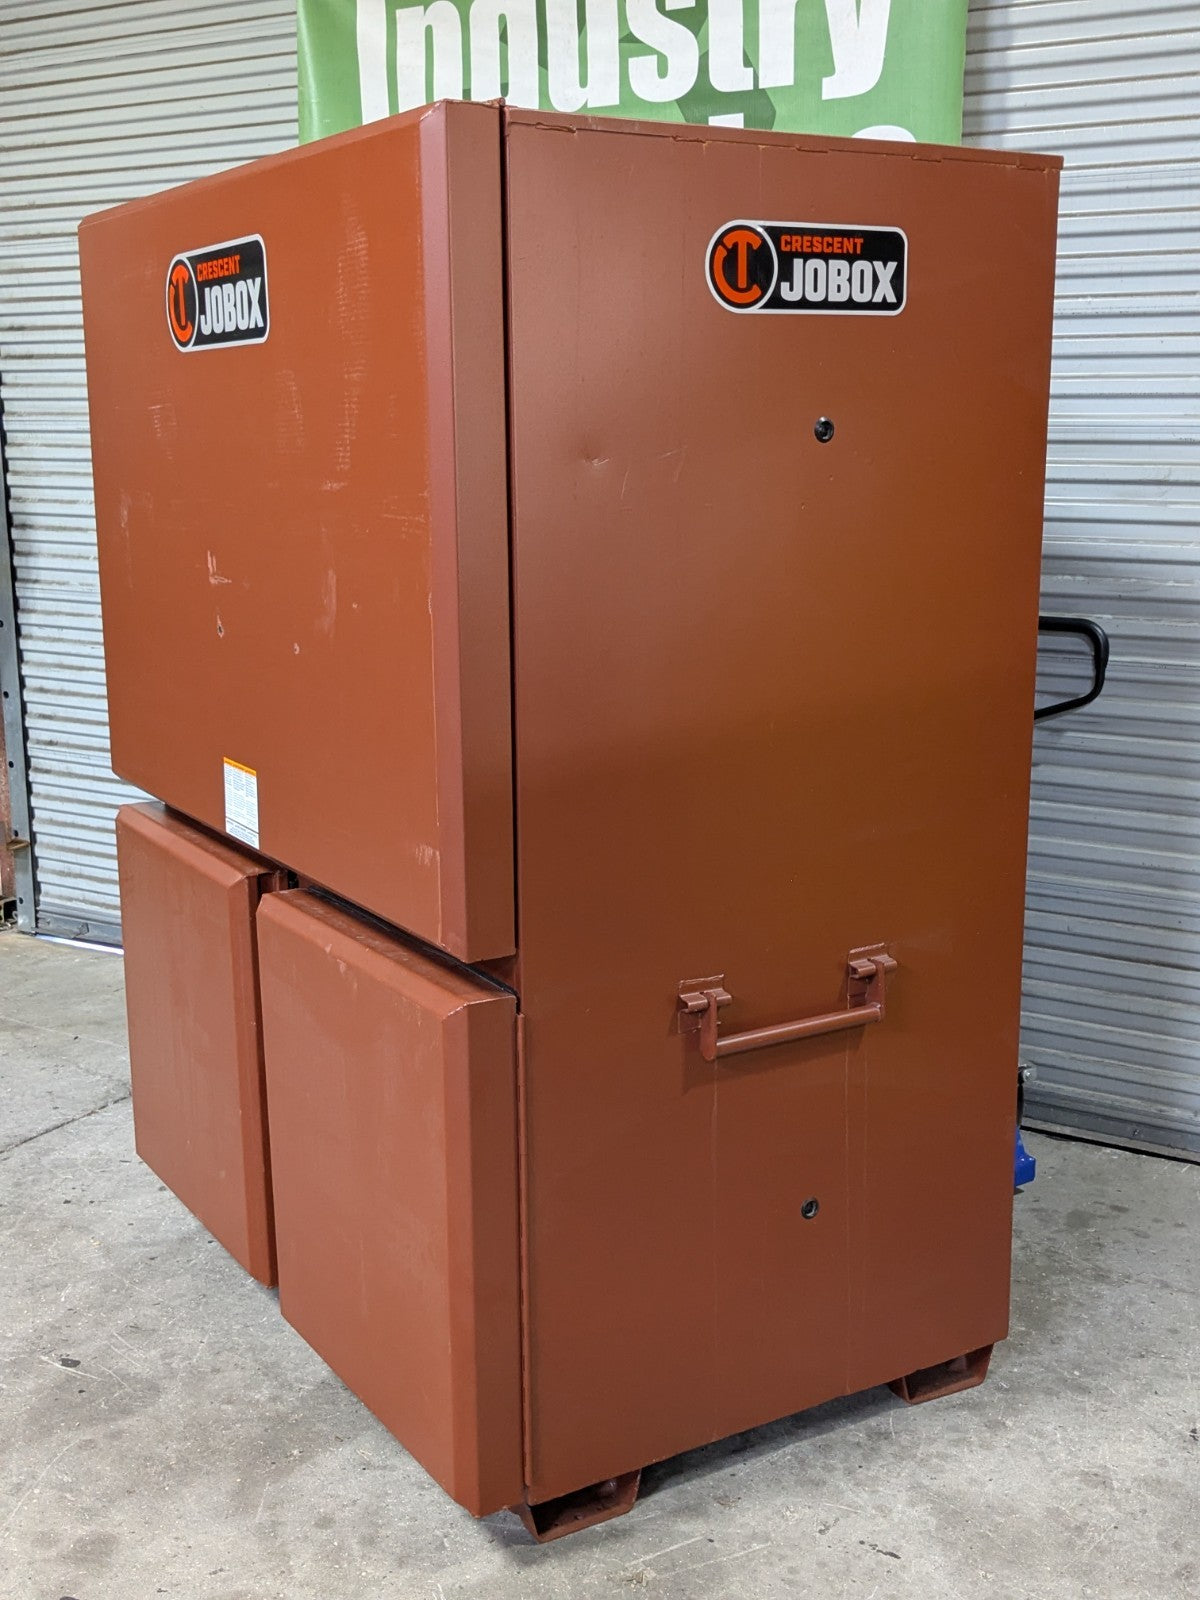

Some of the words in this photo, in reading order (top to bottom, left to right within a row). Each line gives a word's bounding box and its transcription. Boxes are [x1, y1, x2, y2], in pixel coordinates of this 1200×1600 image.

[356, 0, 891, 126] Industry
[780, 235, 864, 254] CRESCENT
[196, 254, 241, 282] CRESCENT
[780, 258, 898, 304] JOBOX
[200, 276, 264, 336] JOBOX
